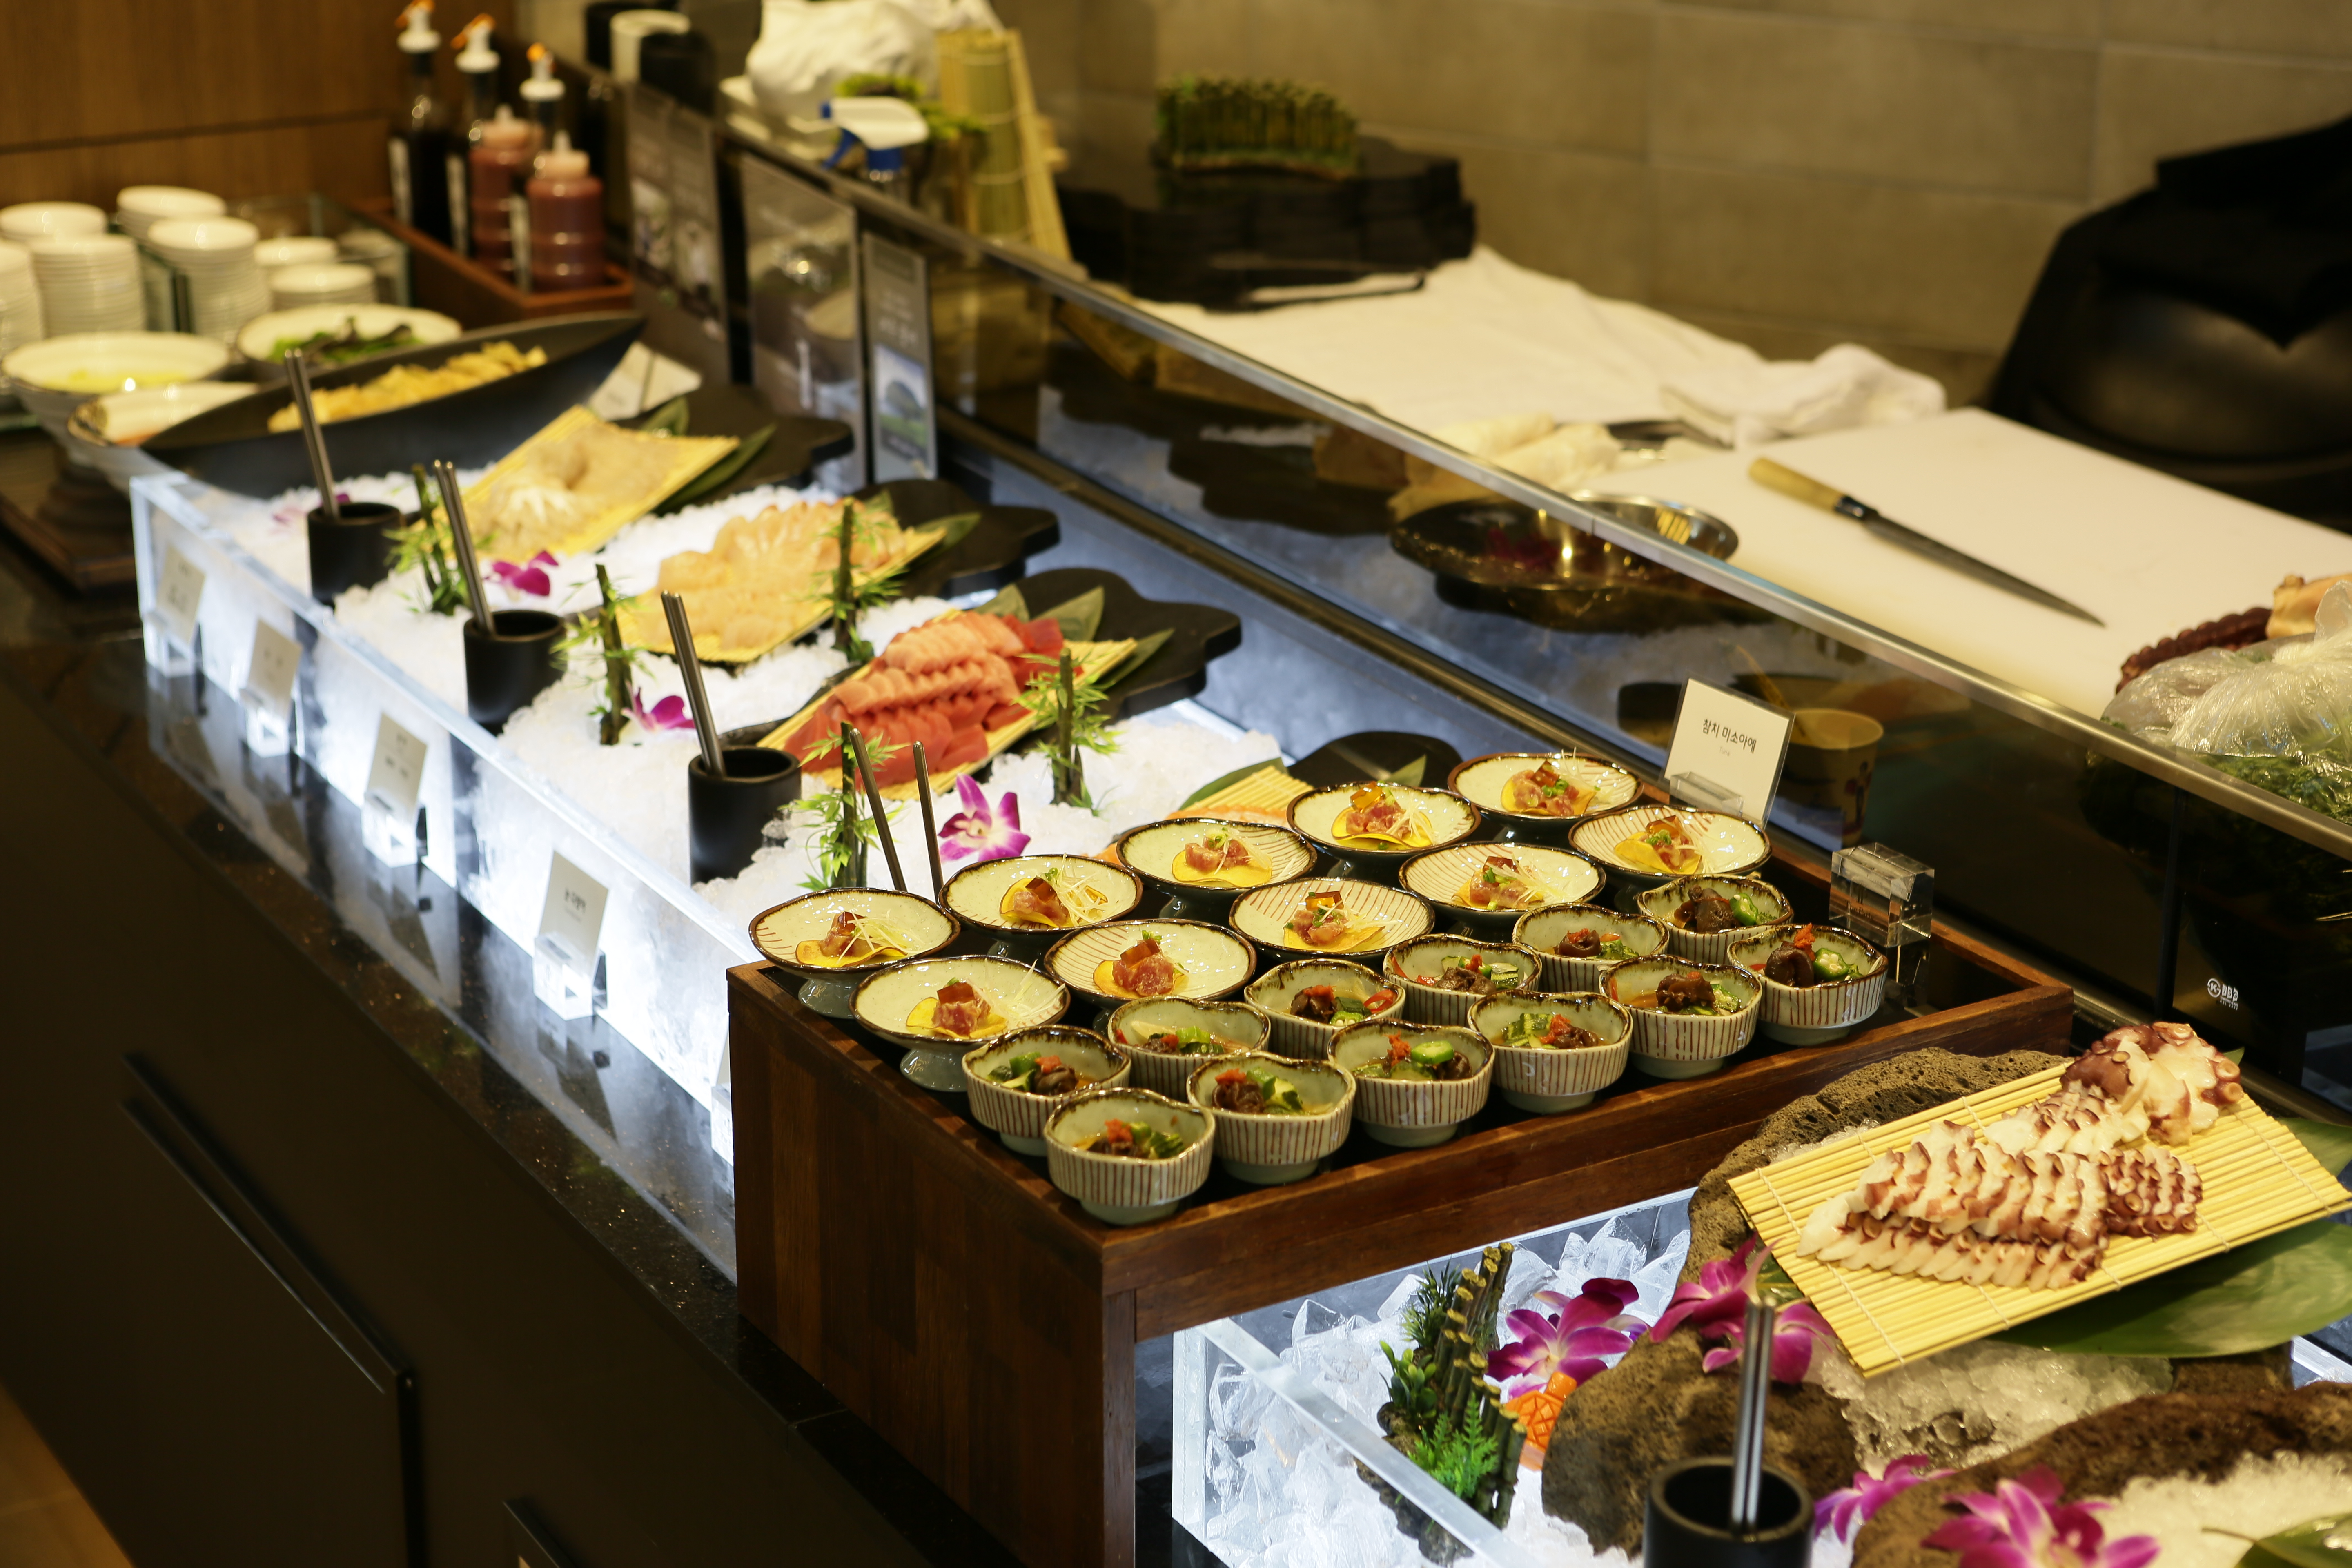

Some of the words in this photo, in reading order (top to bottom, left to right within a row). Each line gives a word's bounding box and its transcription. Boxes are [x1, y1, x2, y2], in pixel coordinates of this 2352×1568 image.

[1702, 719, 1720, 738] 참치
[1722, 727, 1757, 754] 미소아에
[1719, 746, 1730, 757] Tuna
